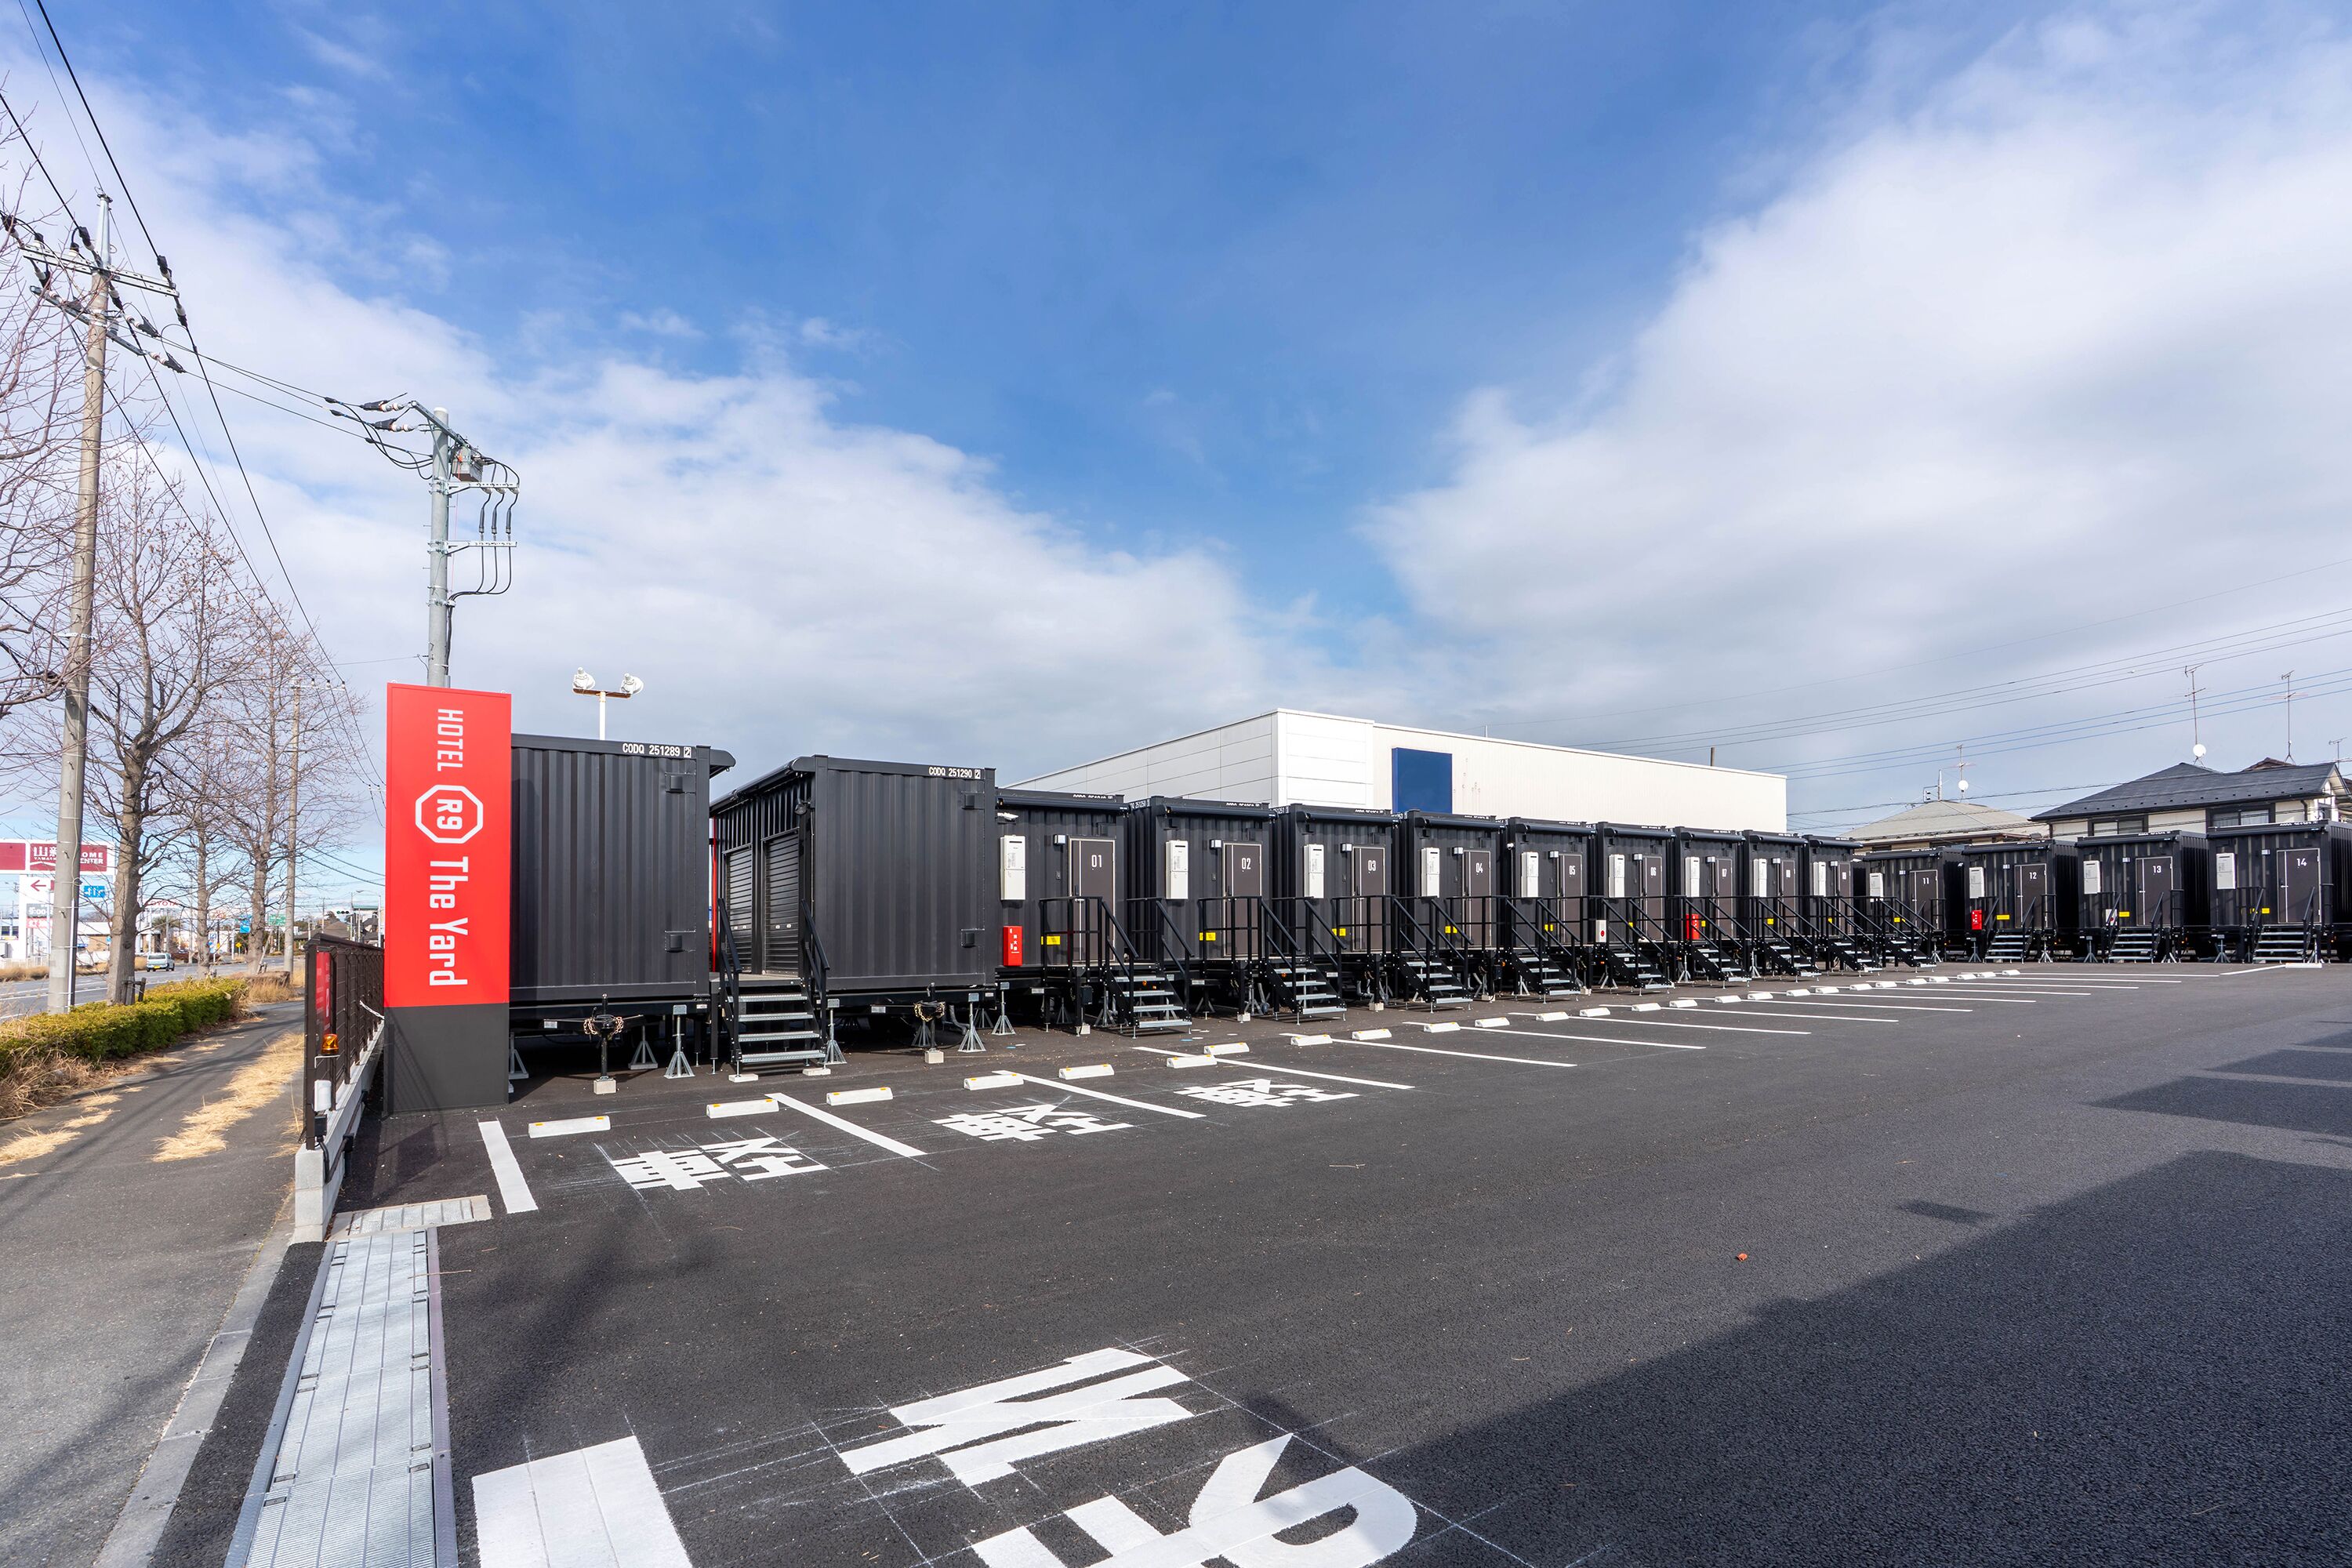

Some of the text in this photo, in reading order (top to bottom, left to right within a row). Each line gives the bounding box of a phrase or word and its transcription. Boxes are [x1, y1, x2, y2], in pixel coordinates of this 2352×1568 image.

[622, 742, 644, 754] CODQ
[649, 744, 681, 757] 251289
[928, 766, 946, 776] CODQ
[949, 768, 972, 778] 251290
[429, 708, 468, 986] HOTEL R9 The Yard
[1091, 855, 1102, 868] 01
[1241, 857, 1250, 869] 02
[1368, 859, 1376, 871] 03
[1475, 862, 1483, 873] 04
[2296, 858, 2307, 866] 14
[1569, 865, 1575, 875] 05
[2152, 865, 2161, 873] 13
[2029, 872, 2037, 880] 12
[1173, 1078, 1359, 1108] 軽
[932, 1104, 1134, 1142] 軽
[611, 1137, 829, 1191] 軽
